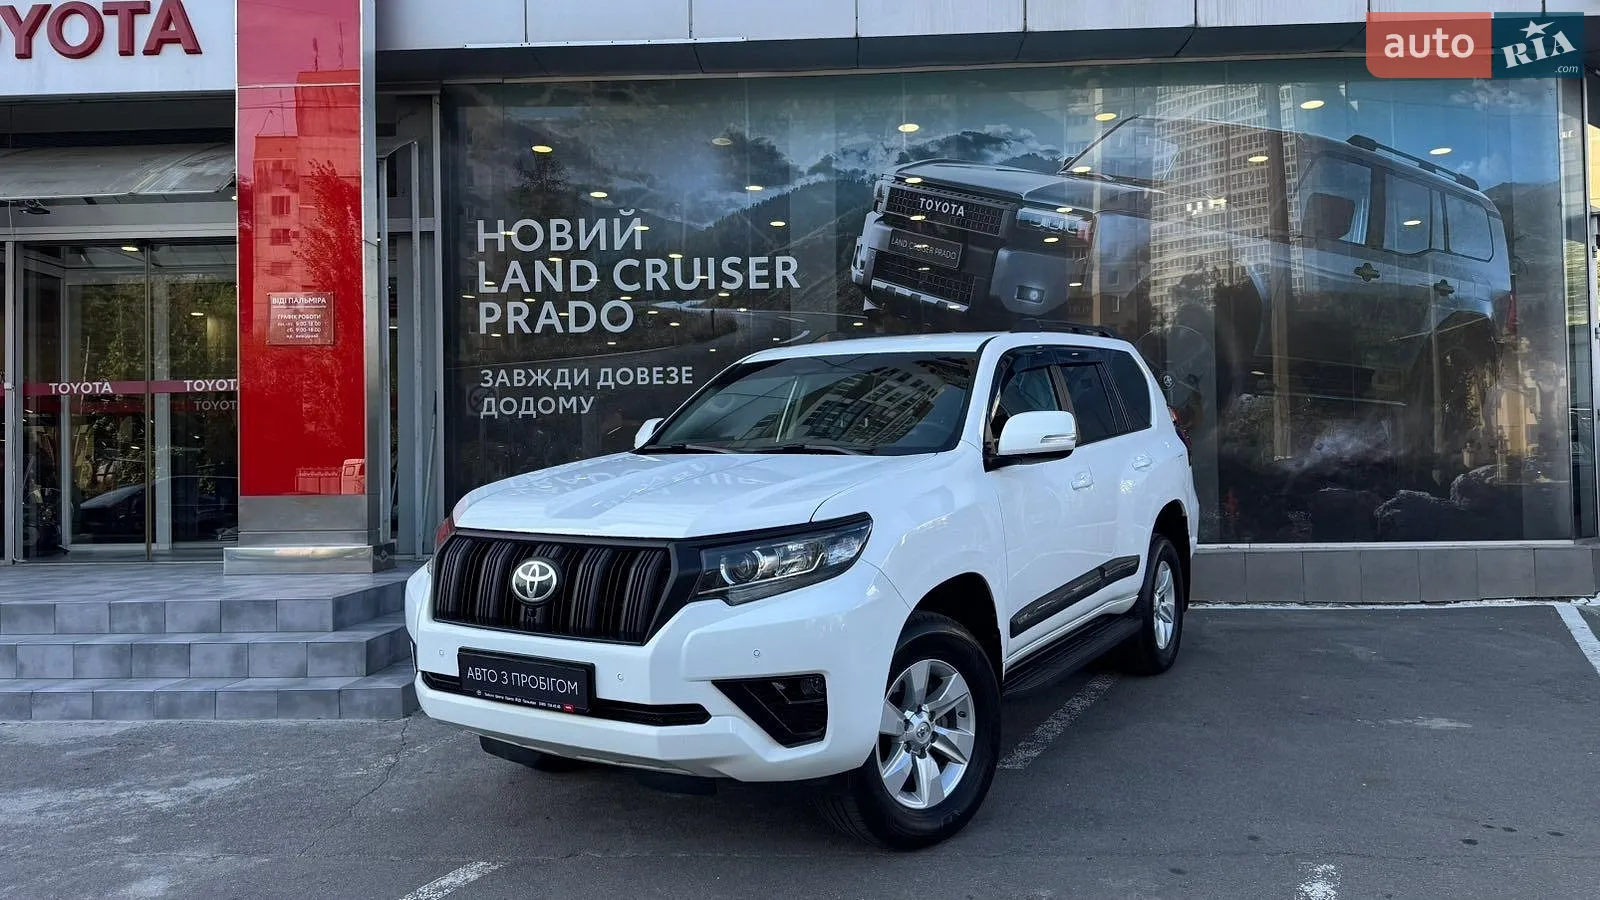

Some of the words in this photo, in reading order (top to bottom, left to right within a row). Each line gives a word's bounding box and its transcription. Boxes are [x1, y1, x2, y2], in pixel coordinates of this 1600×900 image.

[0, 0, 203, 59] YOTA
[919, 197, 965, 218] TOYOTA
[477, 208, 643, 253] НОВИЙ
[891, 236, 908, 248] LAND
[908, 241, 935, 254] CSER
[478, 259, 598, 294] LAND
[612, 255, 801, 291] CRUISER
[272, 297, 287, 305] ВІДІ
[479, 299, 635, 335] PRADO
[49, 382, 113, 395] TOYOTA
[183, 379, 239, 392] TOYOT
[480, 367, 590, 390] ЗАВЖДИ
[597, 366, 693, 390] ДОВЕЗЕ
[194, 400, 238, 411] TOYOT
[480, 395, 595, 419] ДОДОМУ
[466, 666, 498, 683] АВТО
[511, 672, 579, 696] ПРОБІГОМ
